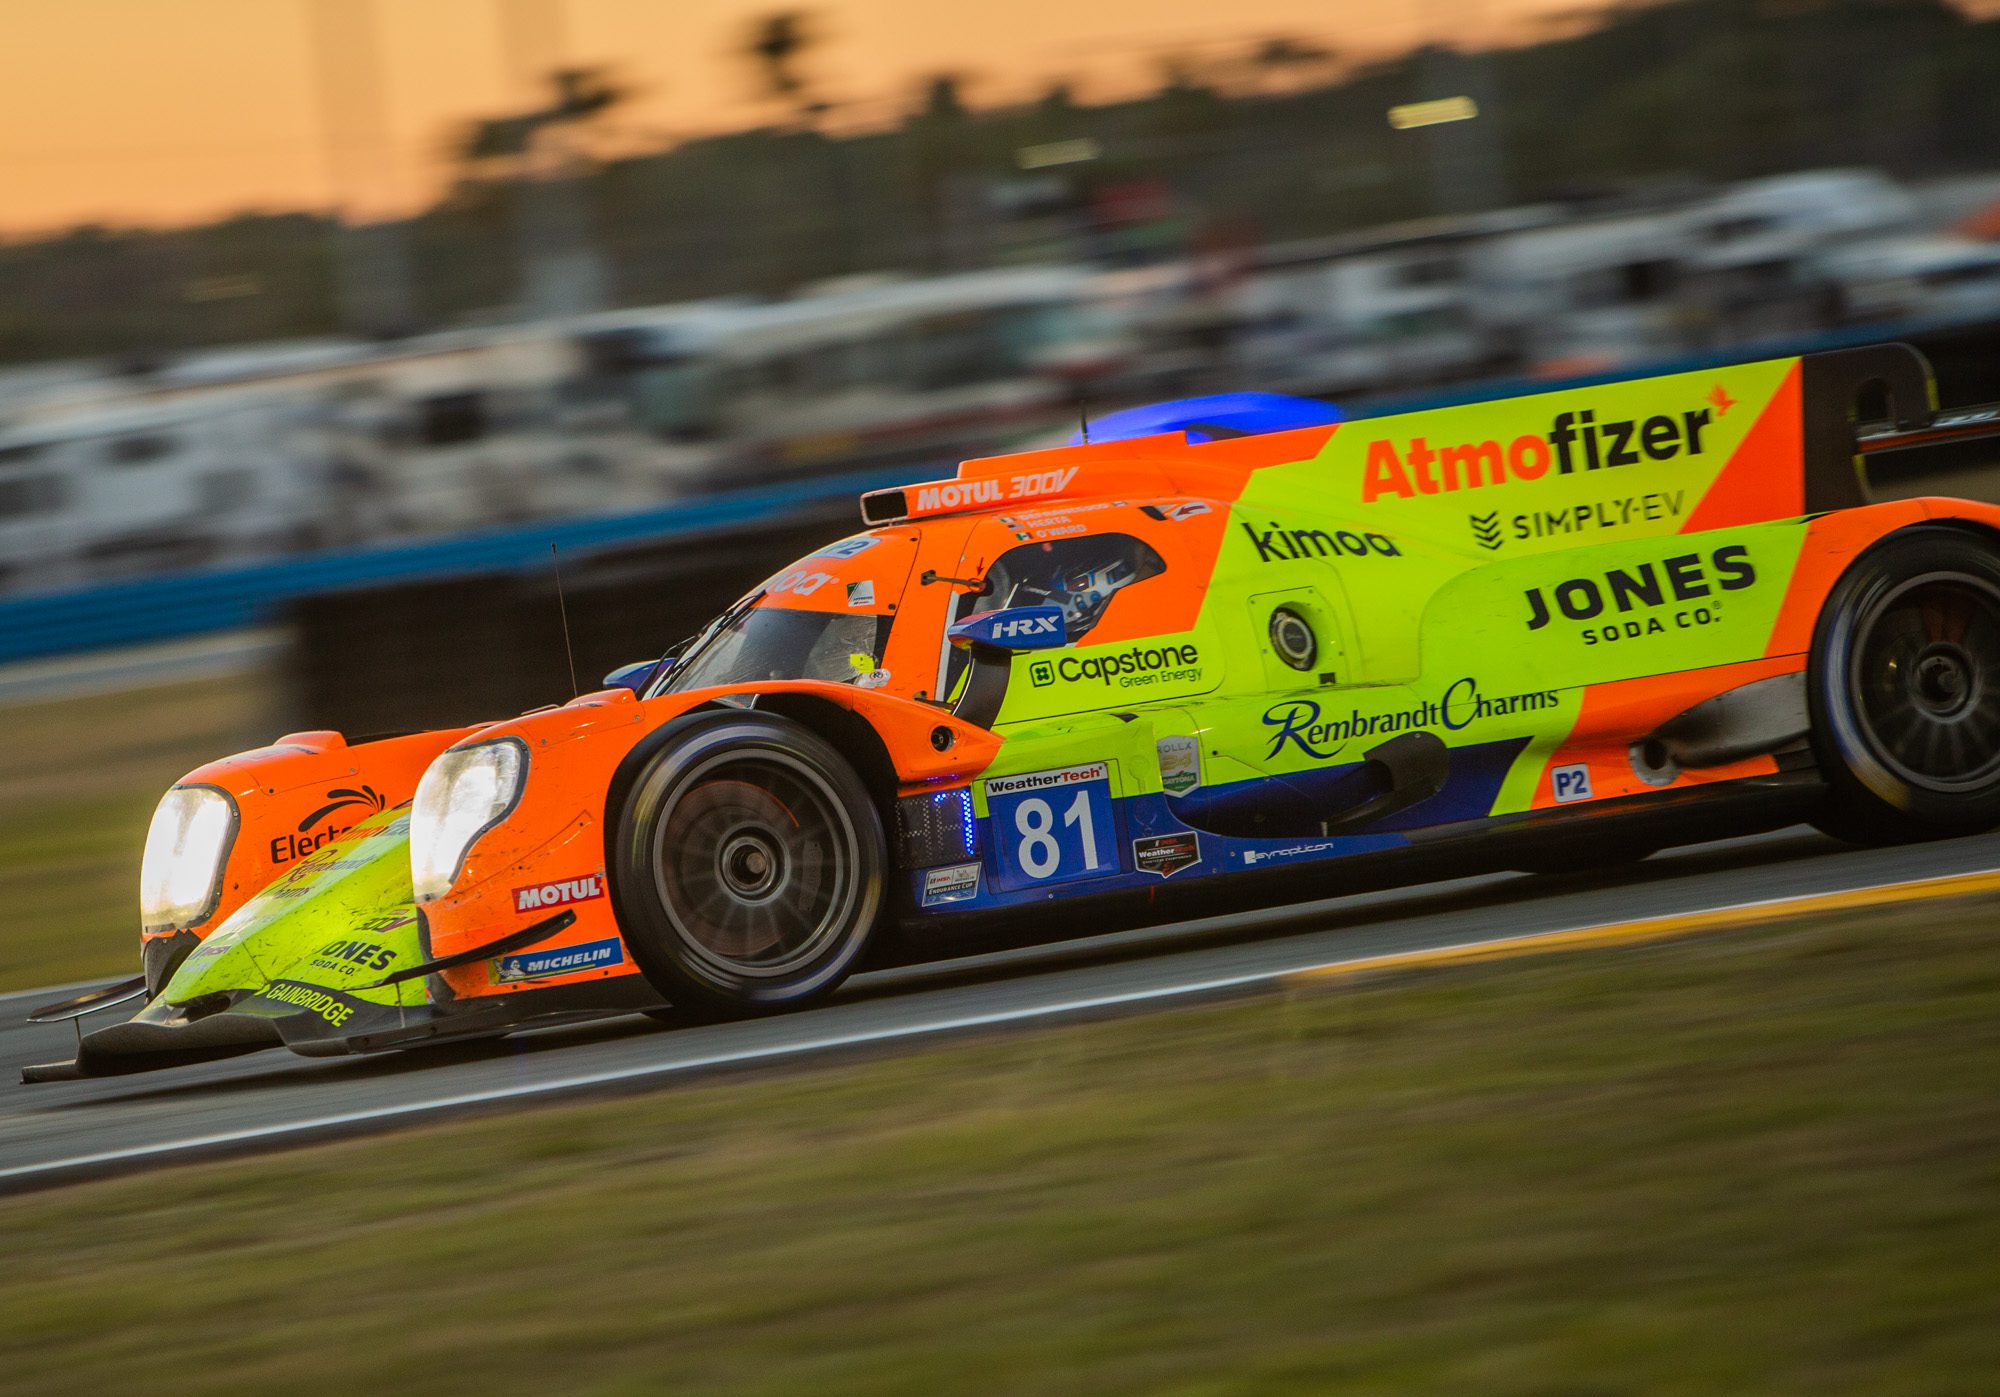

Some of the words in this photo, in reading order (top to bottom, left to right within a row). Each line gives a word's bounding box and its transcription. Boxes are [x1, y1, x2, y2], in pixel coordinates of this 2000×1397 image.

[1362, 407, 1712, 504] Atmofizer
[916, 479, 1004, 512] MOTUL
[1009, 466, 1080, 498] 300V
[1513, 490, 1685, 540] SIMPLY-EV
[1241, 521, 1402, 562] kimoa
[1525, 544, 1757, 631] JONES
[992, 615, 1060, 639] HRX
[1582, 611, 1665, 645] SODA
[1058, 644, 1199, 686] Capstone
[1119, 672, 1159, 688] Green
[1161, 668, 1203, 682] Energy
[1262, 699, 1440, 761] Rembrandt
[1440, 677, 1560, 731] Charms
[989, 767, 1101, 793] WeatherTech
[1555, 769, 1588, 797] P2
[269, 825, 353, 865] Elect
[1014, 789, 1099, 880] 81
[517, 877, 601, 911] MOTUL
[309, 959, 339, 971] SODA
[527, 947, 612, 972] MICHELIN
[266, 983, 354, 1028] GAINBRIDGE
